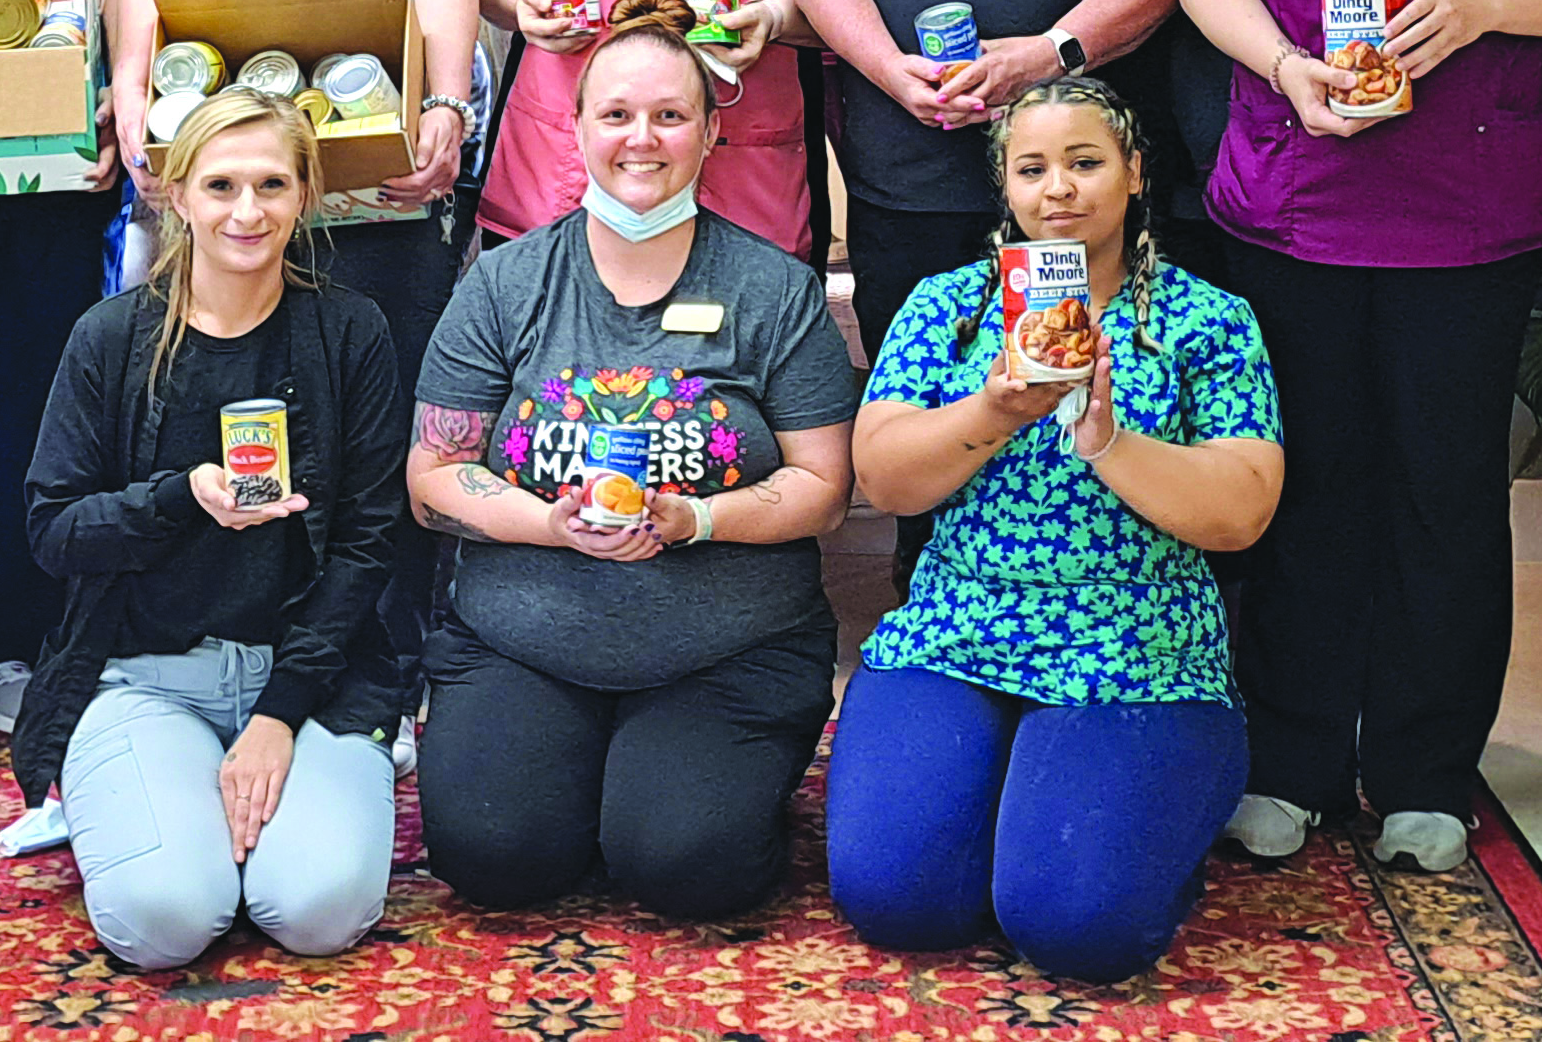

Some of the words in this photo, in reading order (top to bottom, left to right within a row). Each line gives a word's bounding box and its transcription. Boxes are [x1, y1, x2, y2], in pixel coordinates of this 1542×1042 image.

[1330, 11, 1379, 24] Moore
[1041, 251, 1082, 267] Dinty
[1036, 266, 1085, 282] Moore
[228, 428, 272, 446] LUCK'S
[533, 419, 706, 453] KINESS
[534, 450, 706, 484] MAERS
